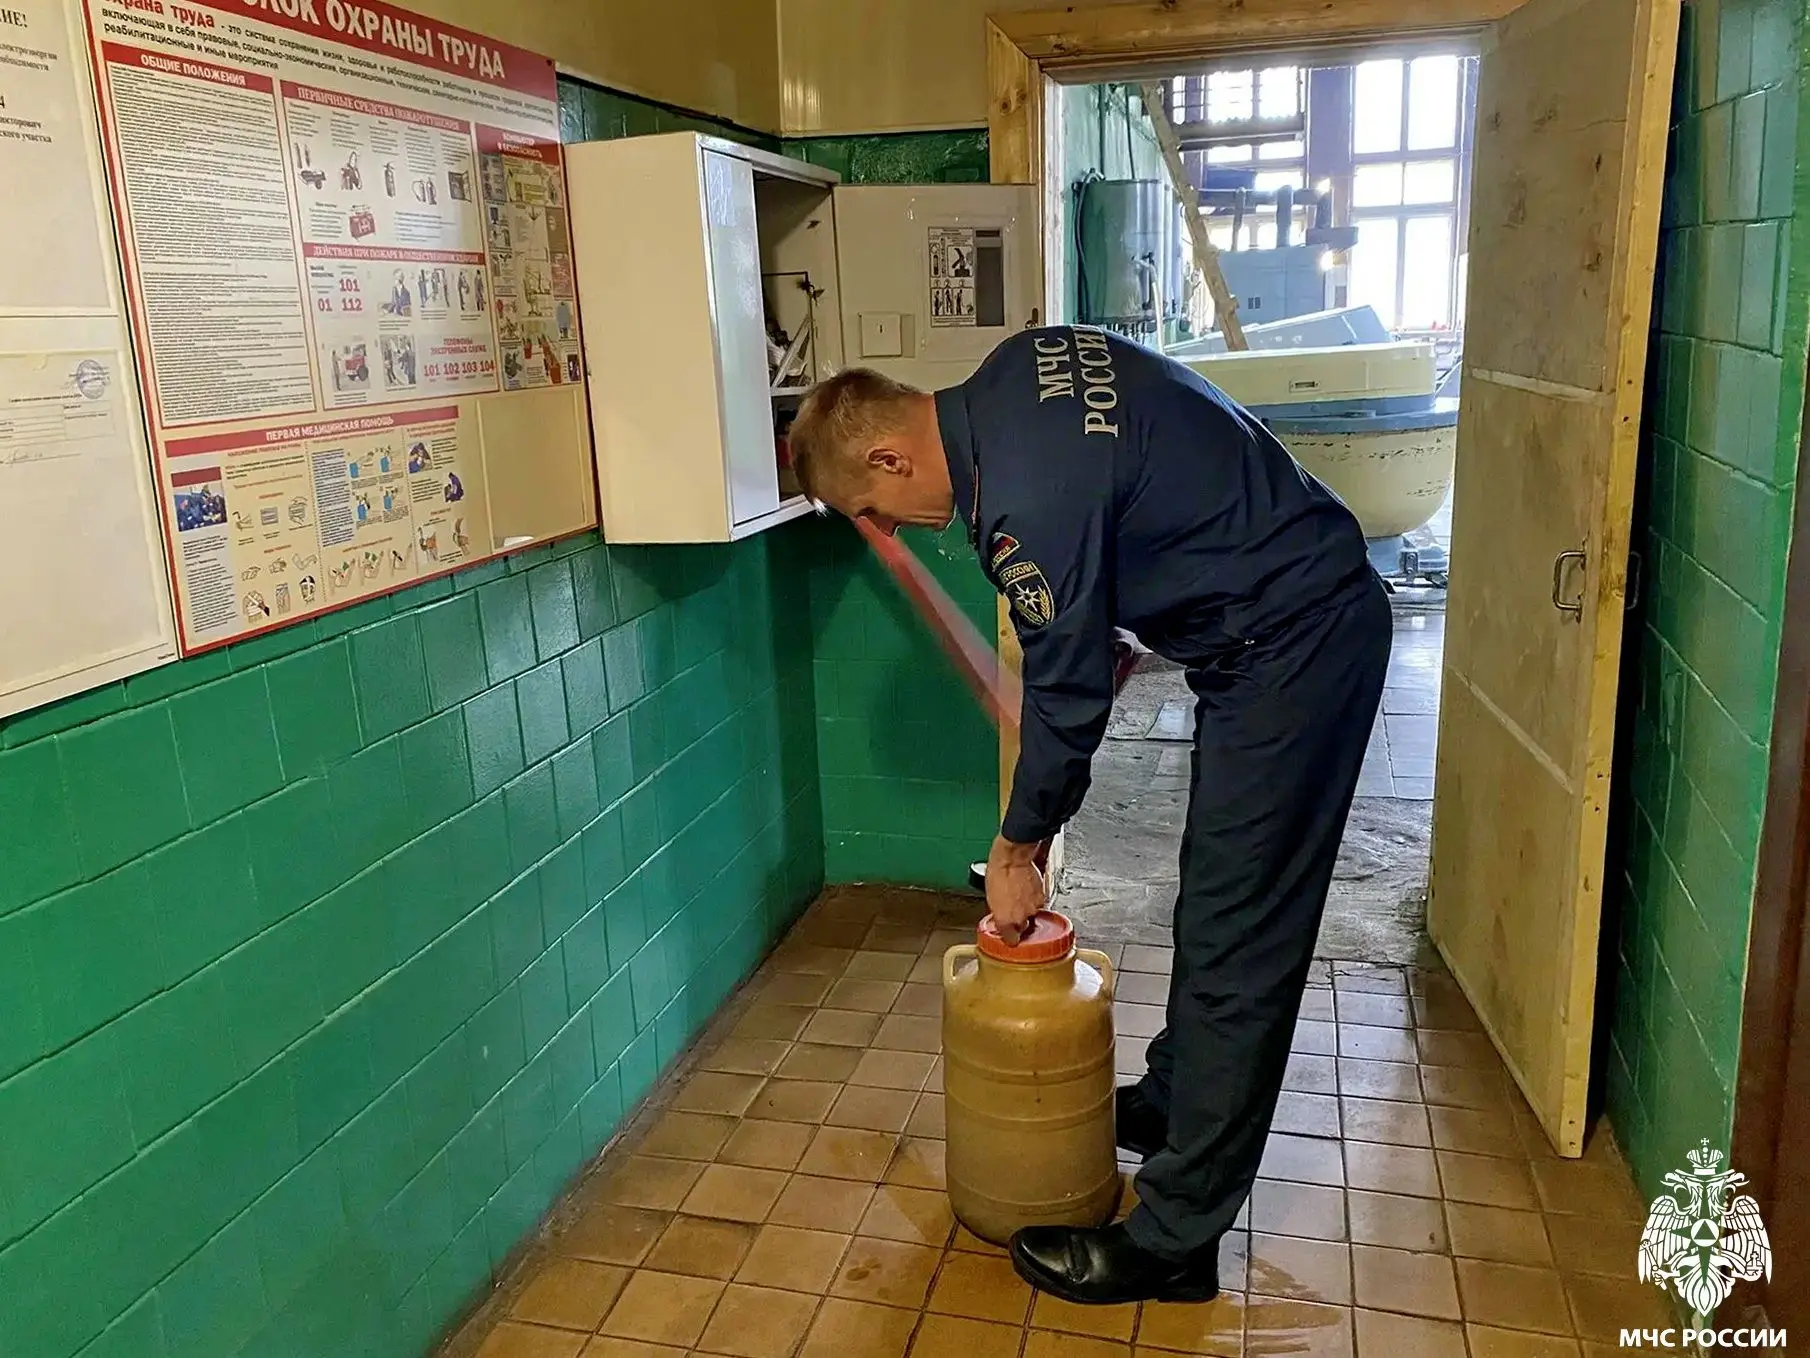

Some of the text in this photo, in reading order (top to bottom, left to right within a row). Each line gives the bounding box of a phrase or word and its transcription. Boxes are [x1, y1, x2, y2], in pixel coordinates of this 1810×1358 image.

[101, 8, 166, 31] включающая
[168, 24, 174, 33] в
[175, 25, 196, 38] себя
[170, 5, 215, 28] труда
[228, 25, 242, 35] это
[245, 29, 276, 44] система
[104, 23, 279, 70] реабилитационные и иные мероприятия
[326, 0, 435, 58] ОХРАНЫ
[438, 31, 506, 79] ТРУДА
[140, 54, 246, 86] ОБЩИЕ ПОЛОЖЕНИЯ
[339, 278, 361, 292] 101
[317, 297, 363, 312] 01 112
[443, 362, 460, 375] 102
[1033, 337, 1075, 403] МЧС
[265, 426, 301, 442] ПЕРВАЯ
[301, 419, 360, 437] МЕДИЦИНСКАЯ
[360, 415, 395, 430] ПОМОЩЬ
